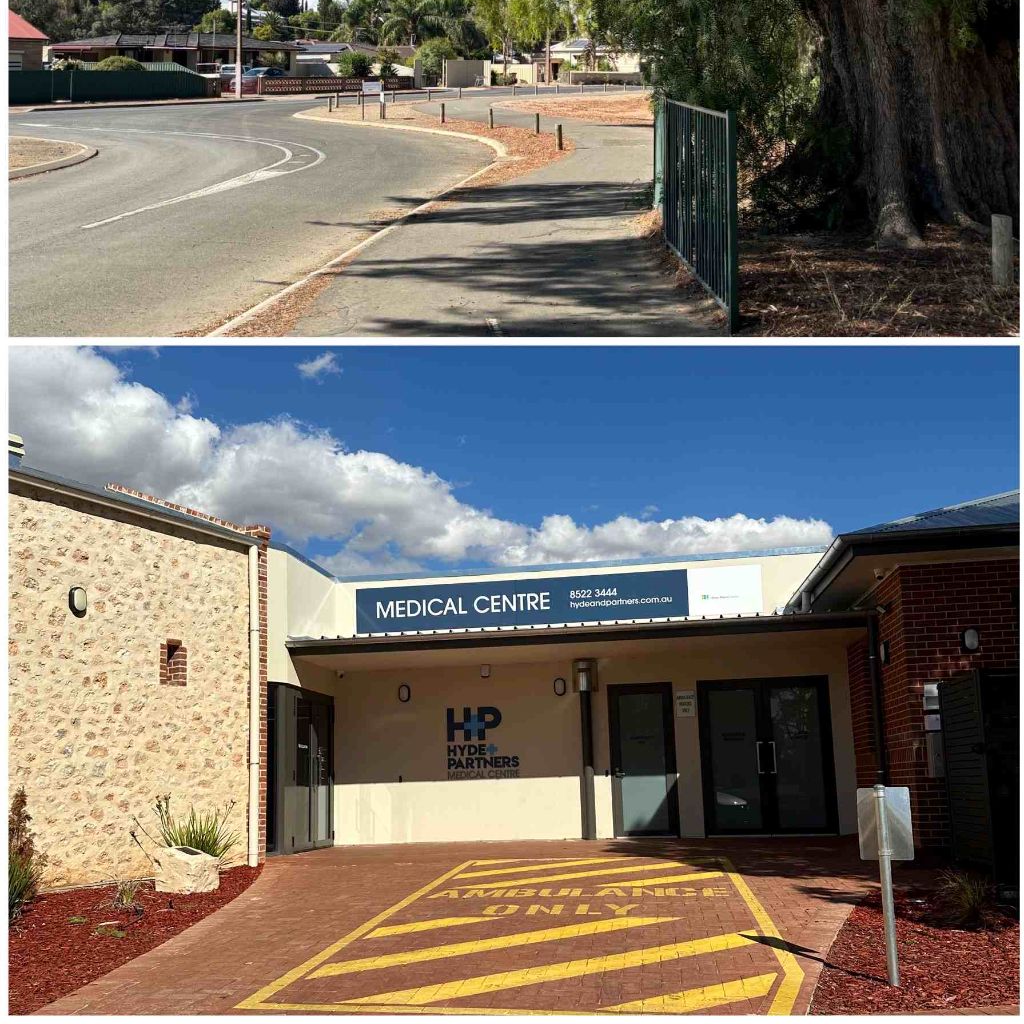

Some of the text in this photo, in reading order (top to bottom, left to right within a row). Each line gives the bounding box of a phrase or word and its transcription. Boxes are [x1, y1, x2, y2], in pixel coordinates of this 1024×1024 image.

[570, 588, 617, 599] 8522 3444
[376, 592, 550, 619] MEDICAL CENTRE
[570, 596, 673, 609] hydeandpartners.com.au
[447, 756, 520, 770] PARTNERS
[447, 769, 520, 780] MEDICAL CENTRE
[428, 886, 730, 898] AMBULANCE
[482, 904, 641, 915] ONLY
